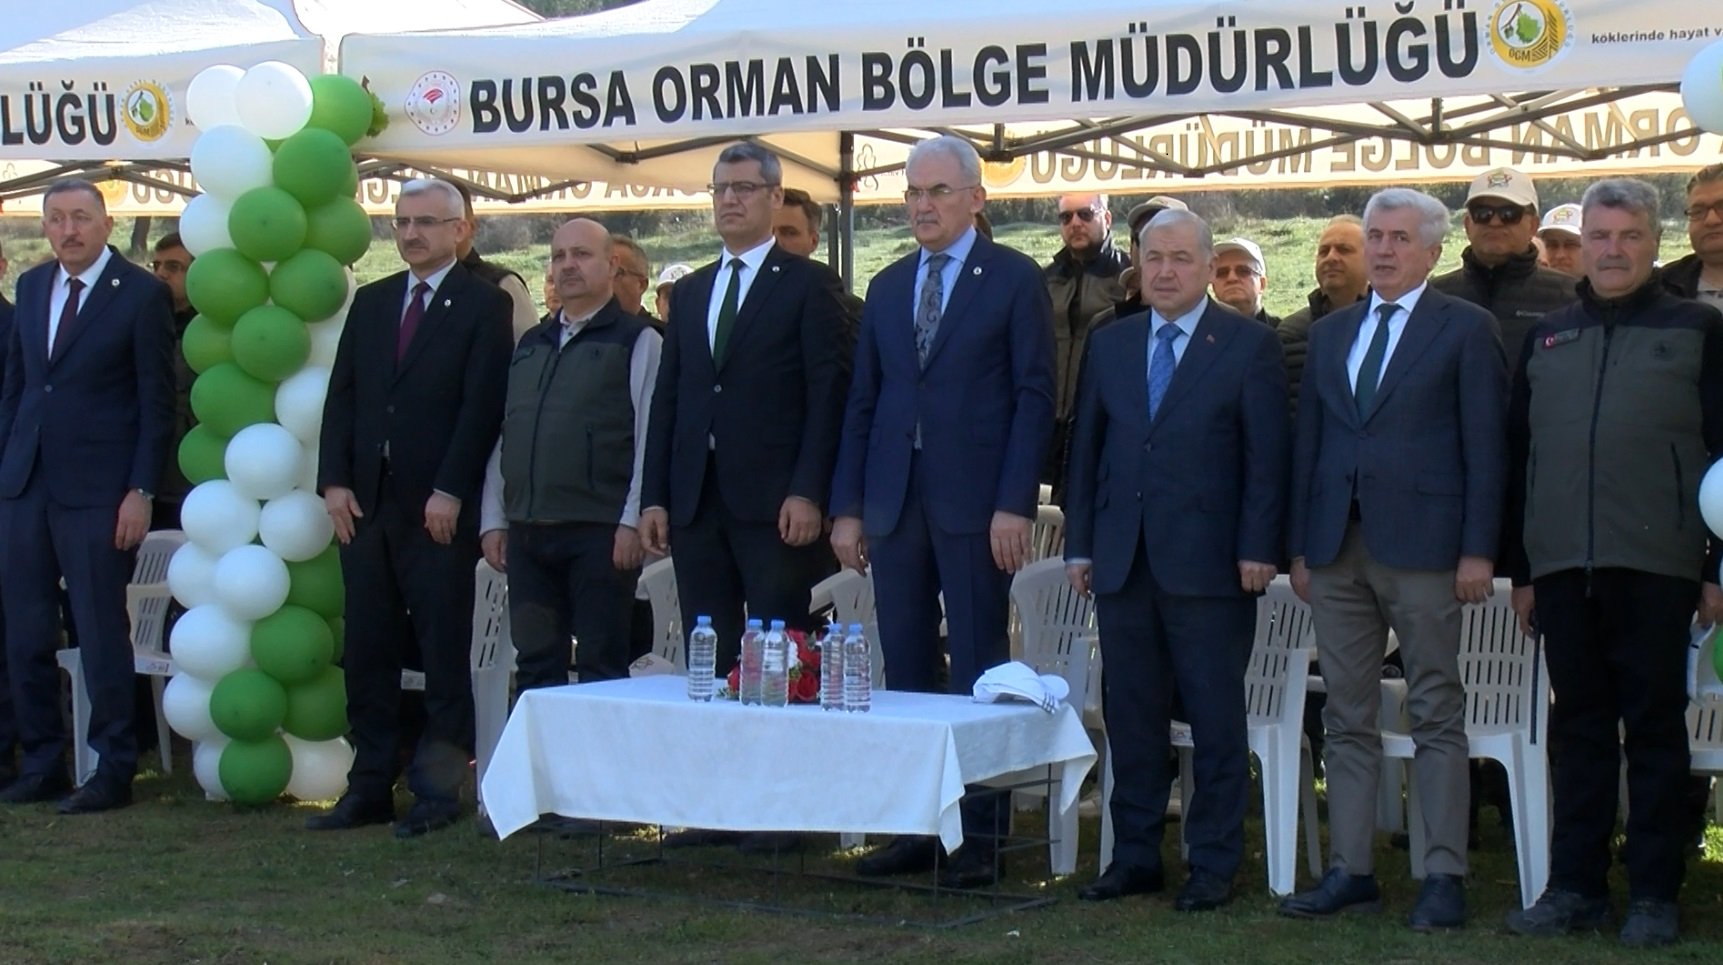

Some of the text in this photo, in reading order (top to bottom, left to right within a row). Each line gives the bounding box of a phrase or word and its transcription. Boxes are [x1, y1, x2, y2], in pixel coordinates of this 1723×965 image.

[470, 0, 1479, 133] BURSA ORMAN BÖLGE MÜDÜRLÜĞÜ
[1591, 30, 1665, 44] köklerinde
[1669, 27, 1709, 41] hayat
